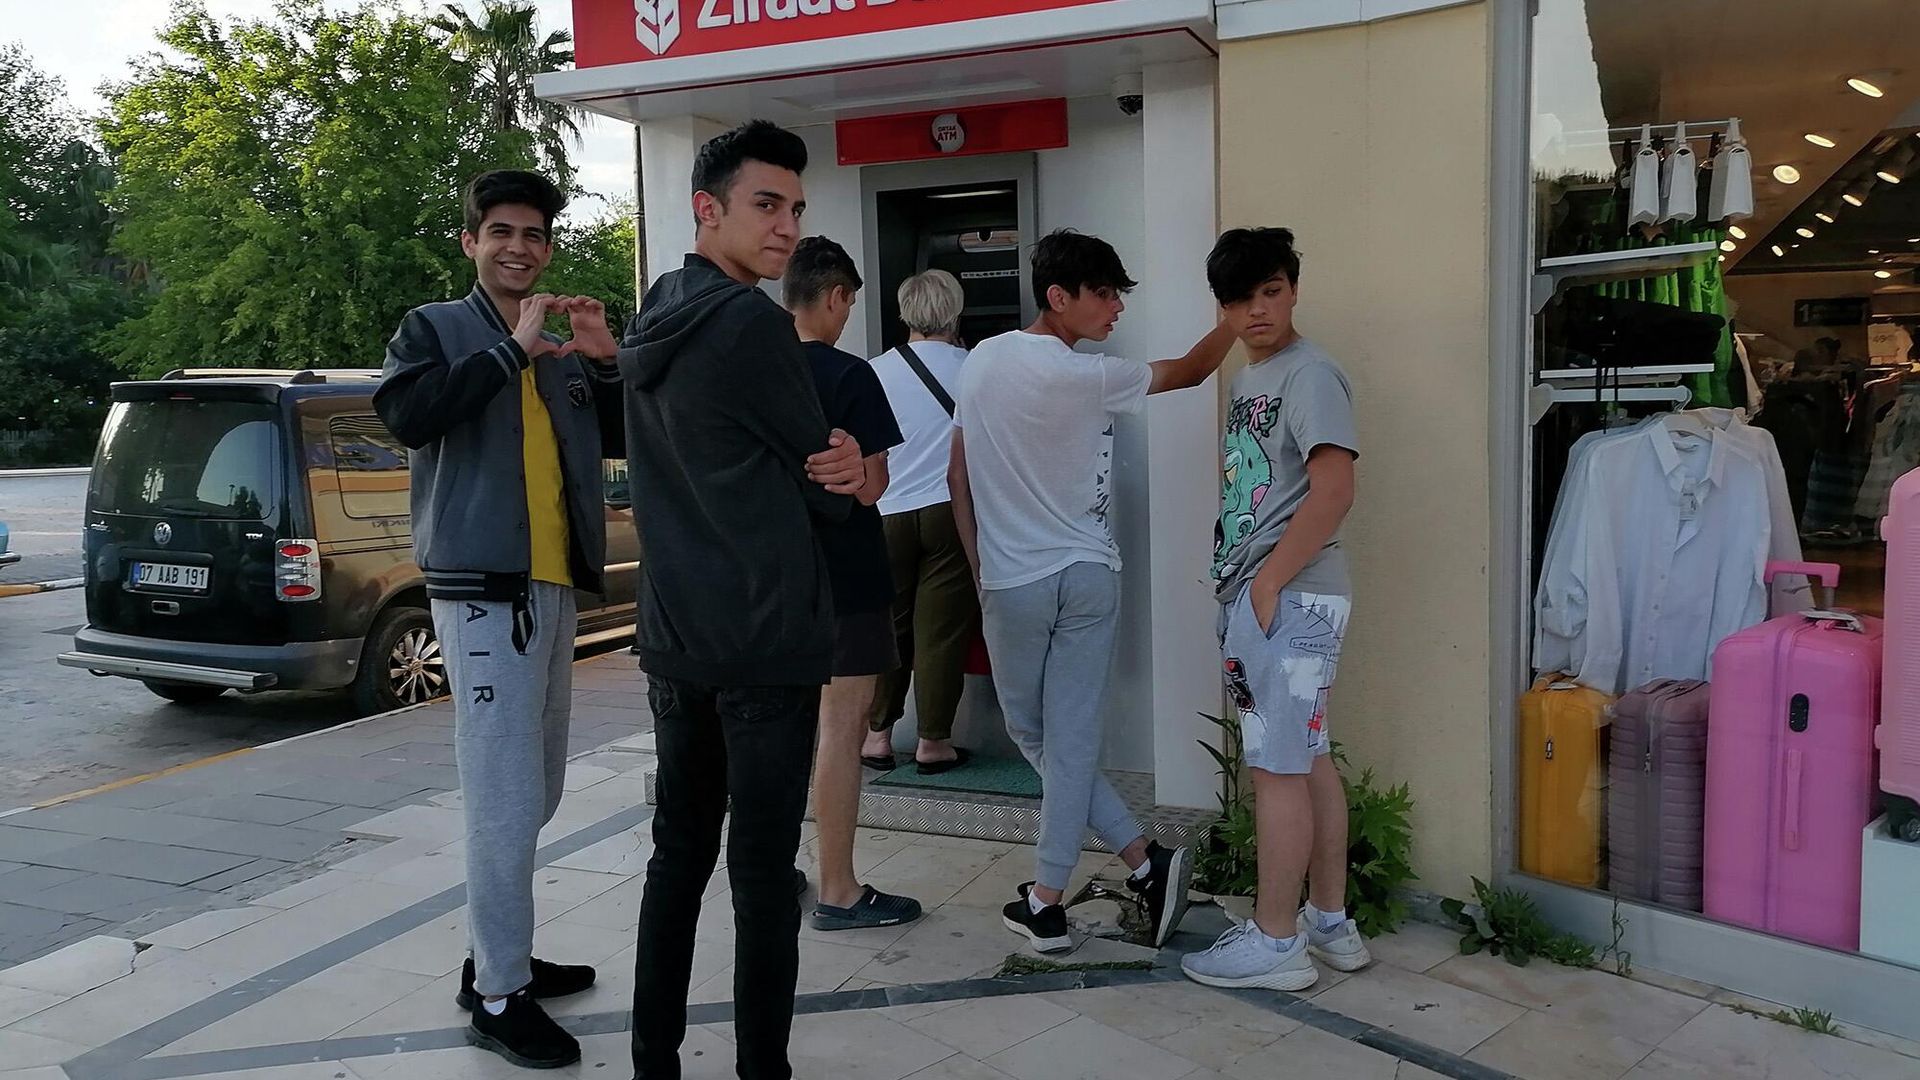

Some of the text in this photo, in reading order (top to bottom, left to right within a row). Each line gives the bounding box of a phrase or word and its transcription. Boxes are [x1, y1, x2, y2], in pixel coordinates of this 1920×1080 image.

[937, 131, 957, 141] ATM
[139, 564, 205, 587] 07 AAB 191
